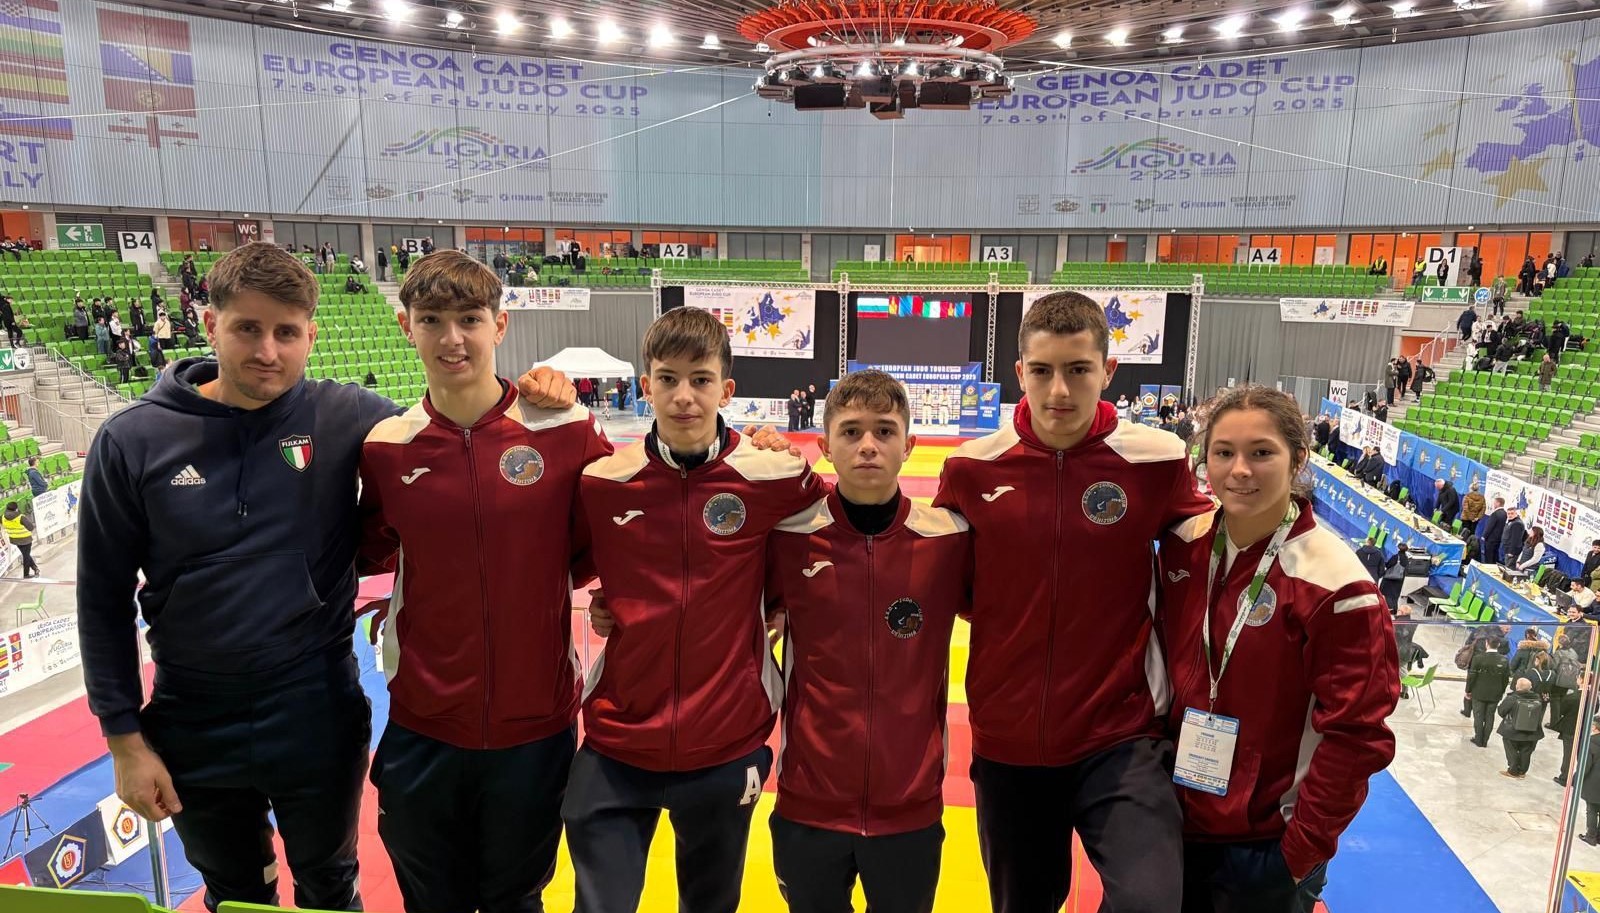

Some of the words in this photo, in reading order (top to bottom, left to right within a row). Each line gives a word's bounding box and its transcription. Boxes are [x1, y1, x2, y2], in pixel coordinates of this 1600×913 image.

[329, 41, 461, 73] GENOA
[473, 58, 584, 80] CADET
[263, 53, 465, 93] EUROPEAN
[478, 78, 568, 98] JUDO
[580, 84, 648, 101] CUP
[1036, 67, 1159, 91] GENOA
[1170, 58, 1289, 82] CADET
[1171, 80, 1268, 104] JUDO
[1280, 75, 1355, 94] CUP
[385, 91, 411, 102] of
[431, 93, 560, 115] February
[576, 104, 641, 117] 2025
[1080, 110, 1107, 123] of
[1124, 103, 1256, 121] February
[1272, 98, 1344, 111] 2025
[427, 141, 548, 160] LIGURIA
[445, 158, 507, 171] 2025
[1115, 151, 1237, 169] LIGURIA
[1130, 169, 1191, 181] 2025
[237, 223, 258, 235] WC
[122, 232, 152, 250] B4
[663, 244, 685, 257] A2
[987, 247, 1009, 260] A3
[1252, 248, 1278, 263] A4
[1429, 247, 1457, 263] D1
[1331, 386, 1347, 396] WC
[281, 438, 309, 448] FIJLKAM
[170, 476, 207, 486] adidas
[739, 764, 762, 806] A
